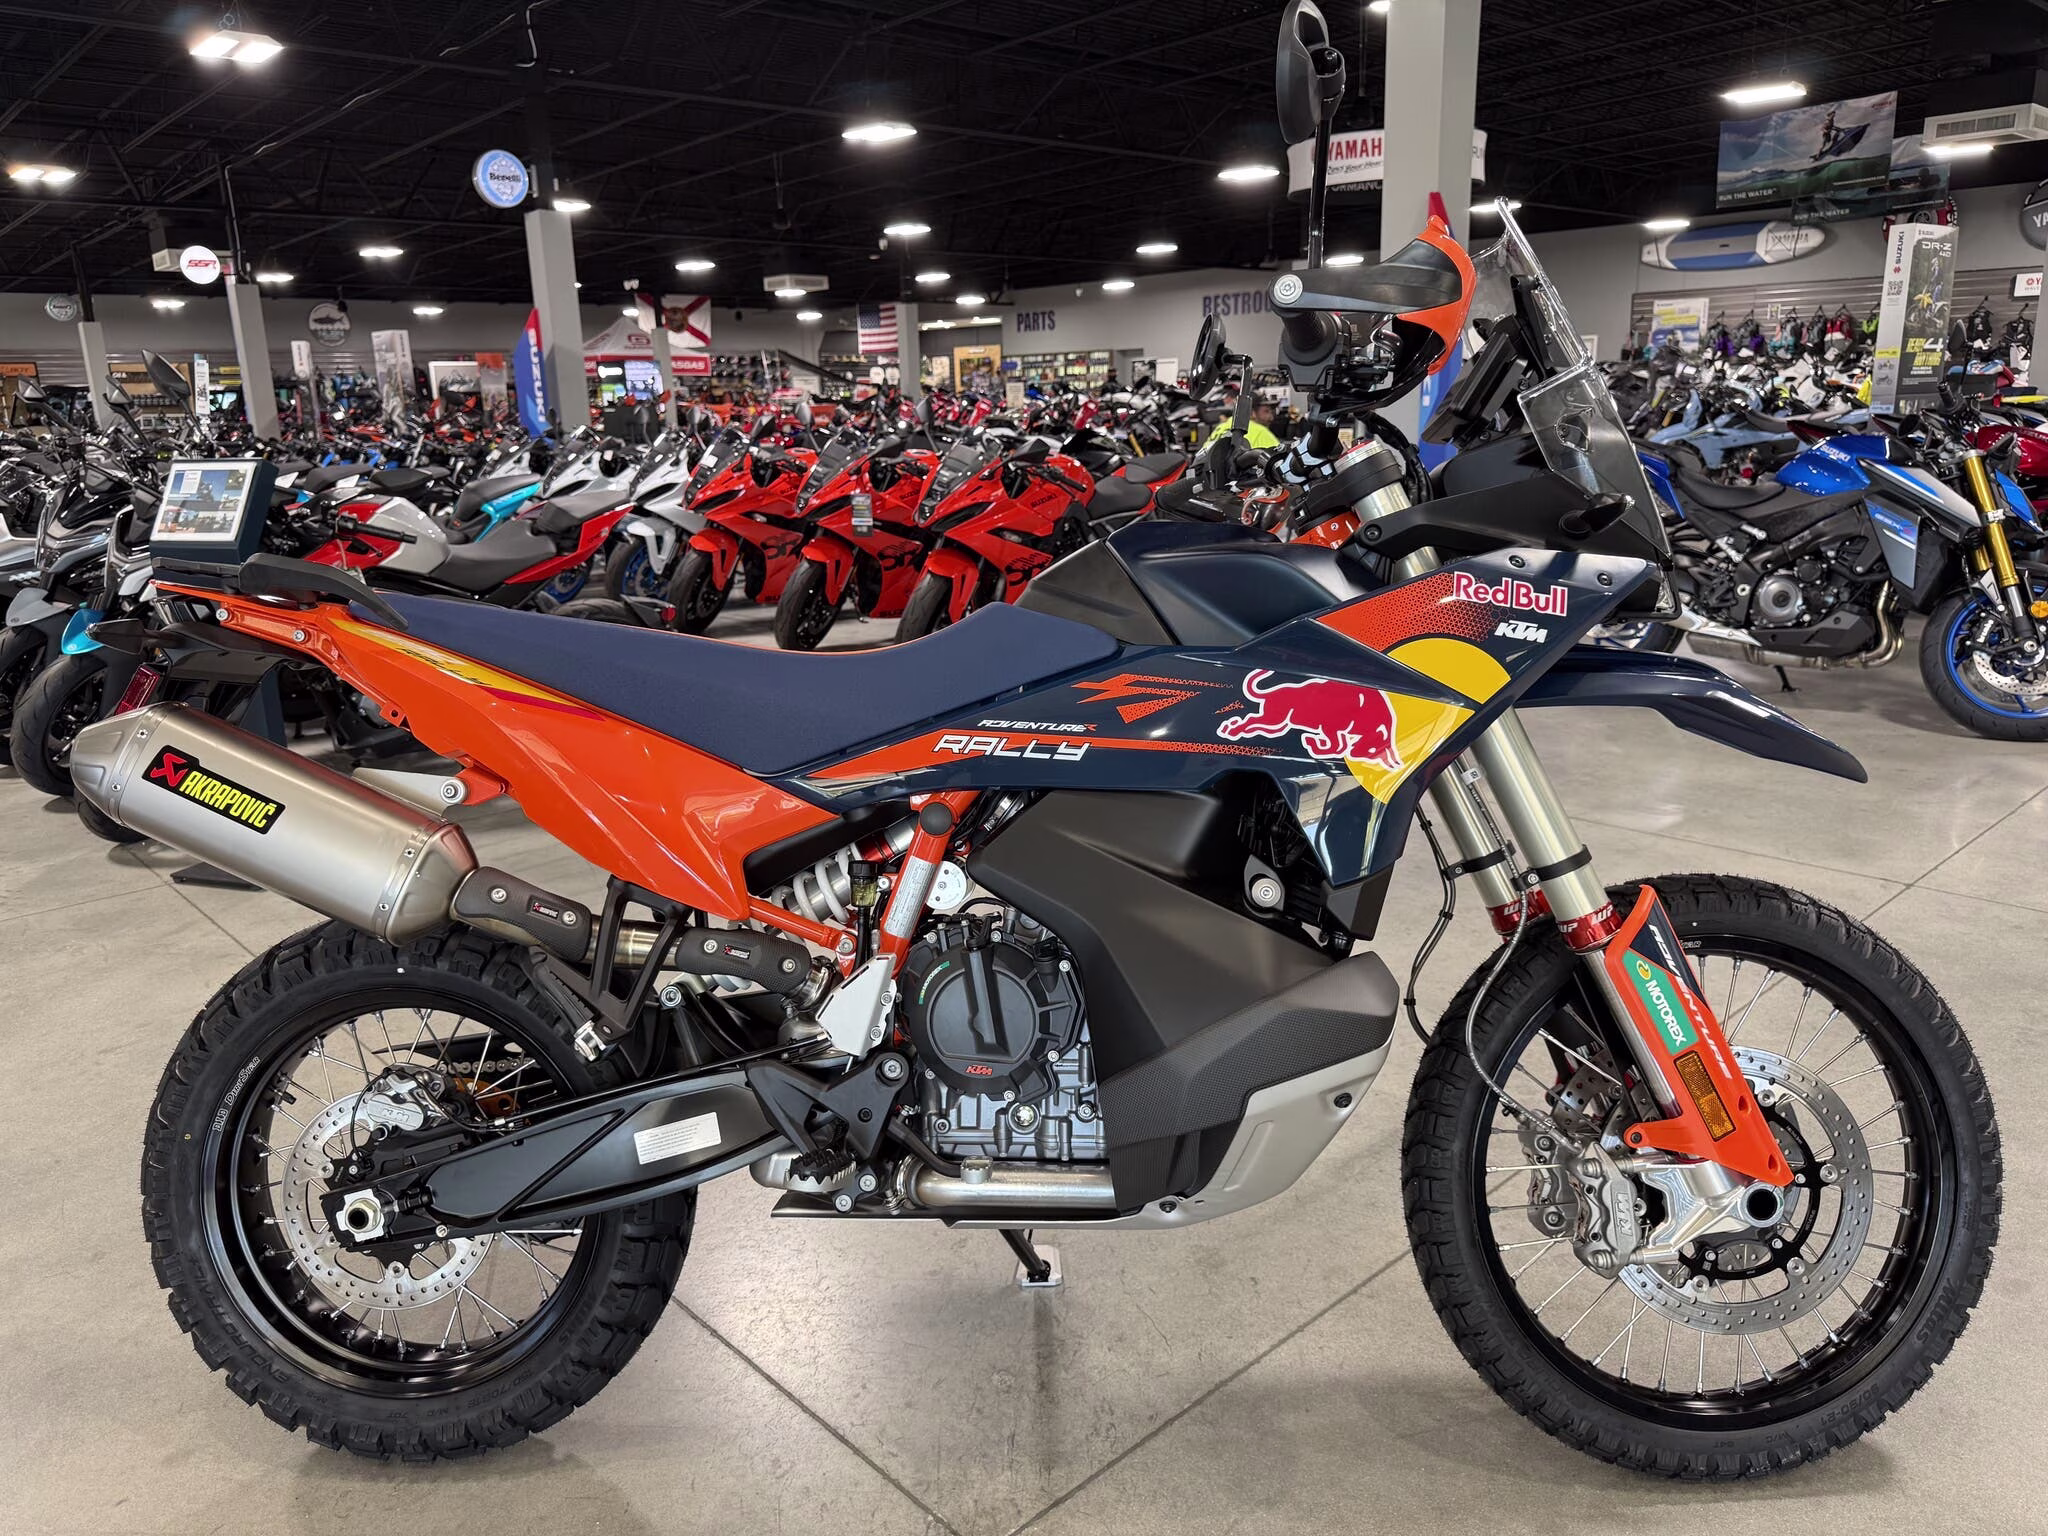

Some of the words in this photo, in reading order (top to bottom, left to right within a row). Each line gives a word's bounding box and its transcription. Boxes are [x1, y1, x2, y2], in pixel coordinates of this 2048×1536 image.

[1329, 137, 1383, 161] YAMAH
[1895, 231, 1905, 265] SUZUKI
[1202, 289, 1272, 318] RESTROO
[1016, 311, 1056, 333] PARTS
[527, 327, 546, 423] SUZUKI
[671, 360, 705, 370] ASGAS
[1819, 444, 1851, 462] SUZUKI
[1454, 571, 1512, 607] Red
[1512, 580, 1568, 617] Bull
[1494, 620, 1548, 643] KTM
[931, 733, 1093, 762] RALLY
[1645, 979, 1687, 1047] MOTOREX
[1649, 924, 1733, 1079] ADVENTURE
[965, 1065, 993, 1076] KTM
